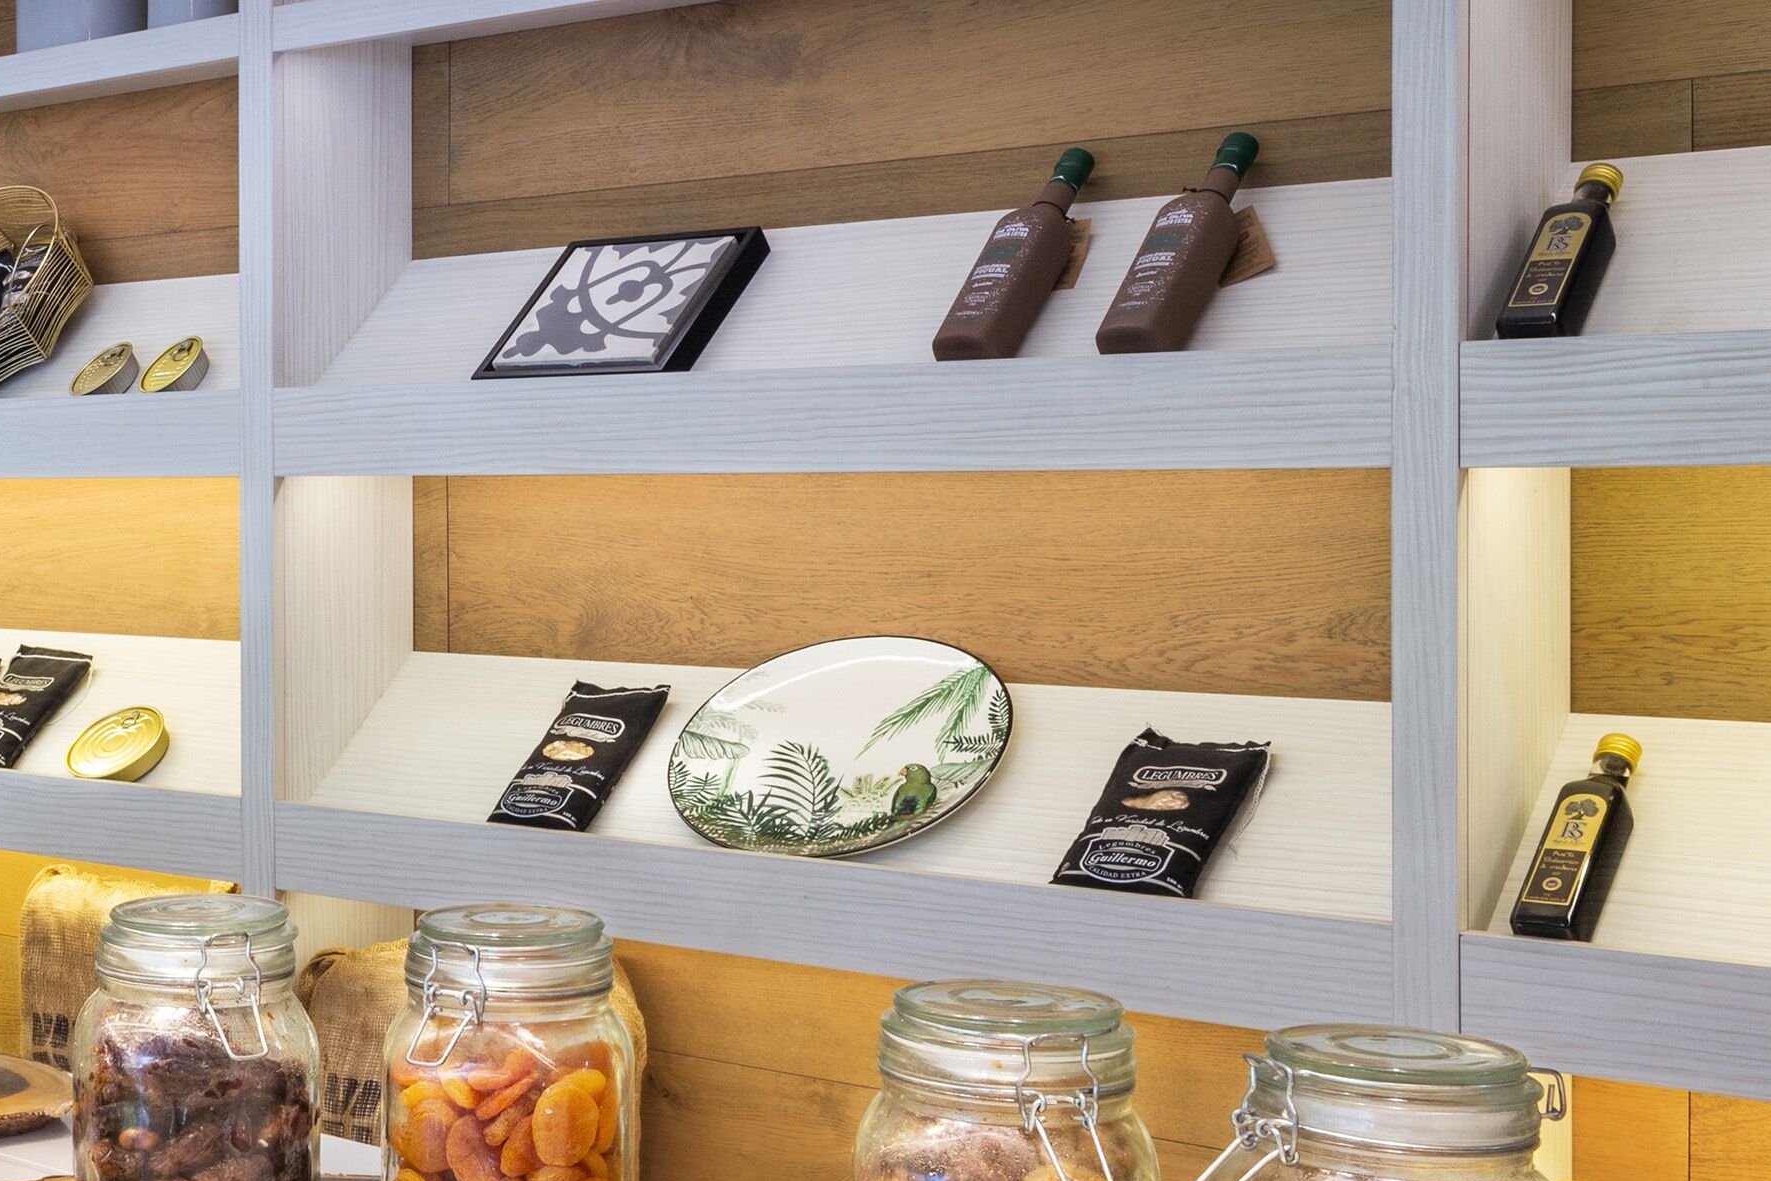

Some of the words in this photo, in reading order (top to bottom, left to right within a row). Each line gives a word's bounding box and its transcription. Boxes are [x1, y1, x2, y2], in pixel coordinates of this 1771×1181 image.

[560, 715, 619, 735] LEGUMBRES
[1141, 770, 1219, 780] LEGUMBRES
[506, 793, 558, 806] Guillermo
[1166, 820, 1210, 840] Legumbres
[1099, 841, 1156, 855] Legumbres
[1088, 853, 1157, 867] Guillermo
[1088, 866, 1118, 878] CALIDAD
[1120, 871, 1147, 879] EXTRA
